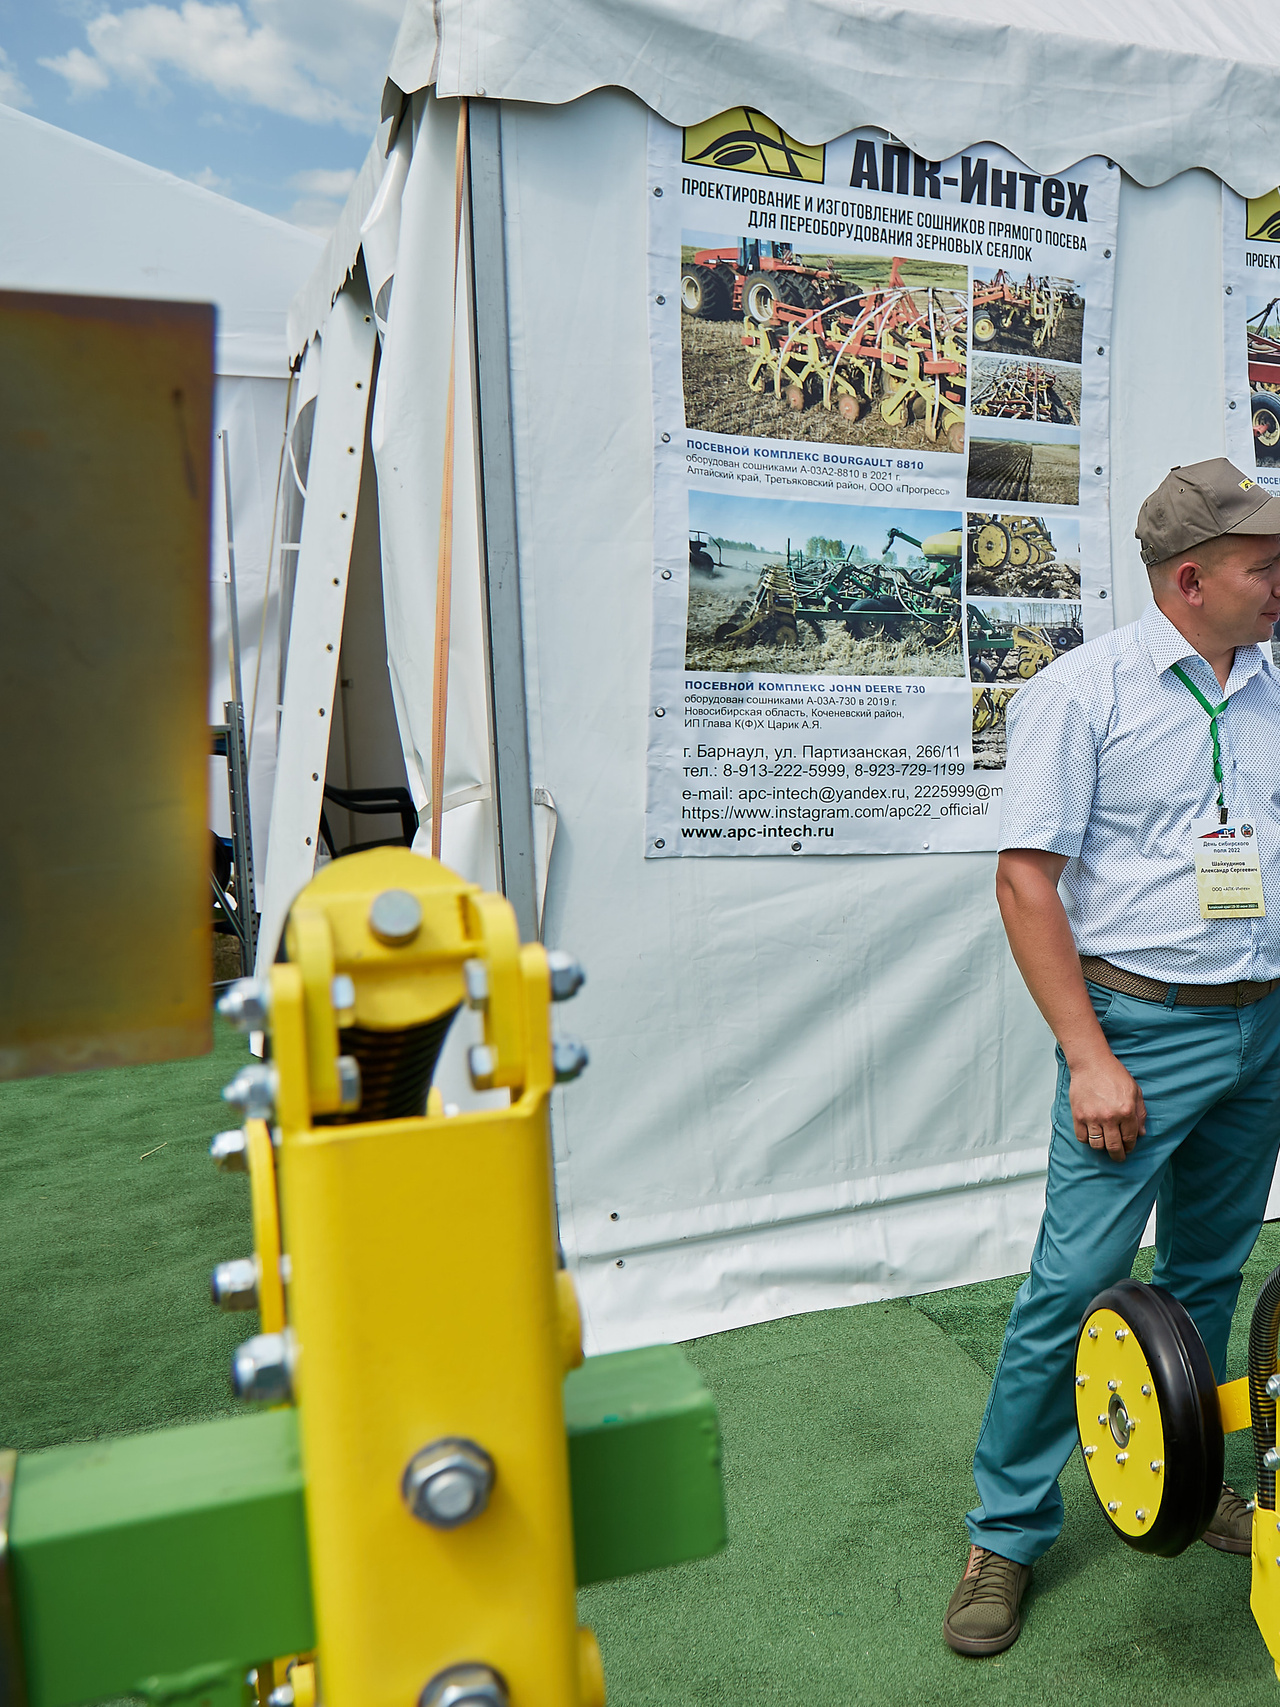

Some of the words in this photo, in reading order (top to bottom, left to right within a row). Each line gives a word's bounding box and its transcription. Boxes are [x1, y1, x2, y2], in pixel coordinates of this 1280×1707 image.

[849, 138, 1089, 223] АПК-Интех
[681, 177, 801, 211] ПРОЕКТИРОВАНИЕ
[804, 195, 814, 212] И
[816, 197, 914, 227] ИЗГОТОВЛЕНИЕ
[916, 211, 985, 235] СОШНИКОВ
[988, 221, 1043, 244] ПРЯМОГО
[1045, 230, 1088, 252] ПОСЕВА
[747, 210, 776, 229] ДЛЯ
[780, 214, 913, 247] ПЕРЕОБОРУДОВАНИЯ
[916, 233, 984, 256] ЗЕРНОВЫХ
[986, 241, 1033, 262] СЕЯЛОК
[686, 439, 750, 456] ПОСЕВНОЙ
[753, 447, 819, 462] КОМПЛЕКС
[823, 454, 893, 468] BOURGAULT
[896, 460, 924, 470] 8810
[685, 453, 740, 469] оборудован
[742, 461, 798, 473] сошниками
[862, 470, 868, 479] в
[870, 470, 893, 481] 2021
[895, 473, 901, 481] г.
[686, 465, 735, 480] Алтайский
[736, 472, 762, 484] край,
[764, 473, 834, 488] Третьяковский
[869, 482, 893, 492] ООО
[896, 484, 950, 496] «Прогресс»
[684, 680, 754, 691] ПОСЕВНОЙ
[758, 682, 826, 692] КОМПЛЕКС
[829, 684, 862, 693] JOHN
[865, 684, 903, 693] DEERE
[905, 685, 926, 694] 730
[684, 693, 744, 706] оборудован
[746, 696, 804, 705] сошниками
[858, 698, 865, 706] в
[866, 697, 890, 706] 2019
[891, 698, 897, 707] г.
[684, 706, 762, 718] Новосибирская
[764, 707, 809, 718] область,
[811, 708, 872, 718] Коченевский
[874, 709, 905, 719] район,
[684, 719, 700, 728] ИП
[702, 719, 732, 729] Глава
[734, 719, 765, 731] К(Ф)Х
[767, 720, 799, 731] Царик
[801, 720, 822, 730] А.Я.
[683, 747, 692, 758] г.
[697, 744, 769, 761] Барнаул,
[774, 748, 797, 762] ул.
[802, 745, 911, 761] Партизанская,
[916, 745, 960, 758] 266/11
[683, 765, 717, 778] тел.:
[723, 763, 849, 779] 8-913-222-5999,
[854, 763, 965, 777] 8-923-729-1199
[682, 786, 733, 800] e-mail:
[738, 786, 909, 803] apc-intech@yandex.ru,
[914, 784, 1004, 800] 2225999@m
[682, 803, 989, 822] https://www.instagram.com/apc22_official/
[681, 824, 835, 841] www.apc-intech.ru
